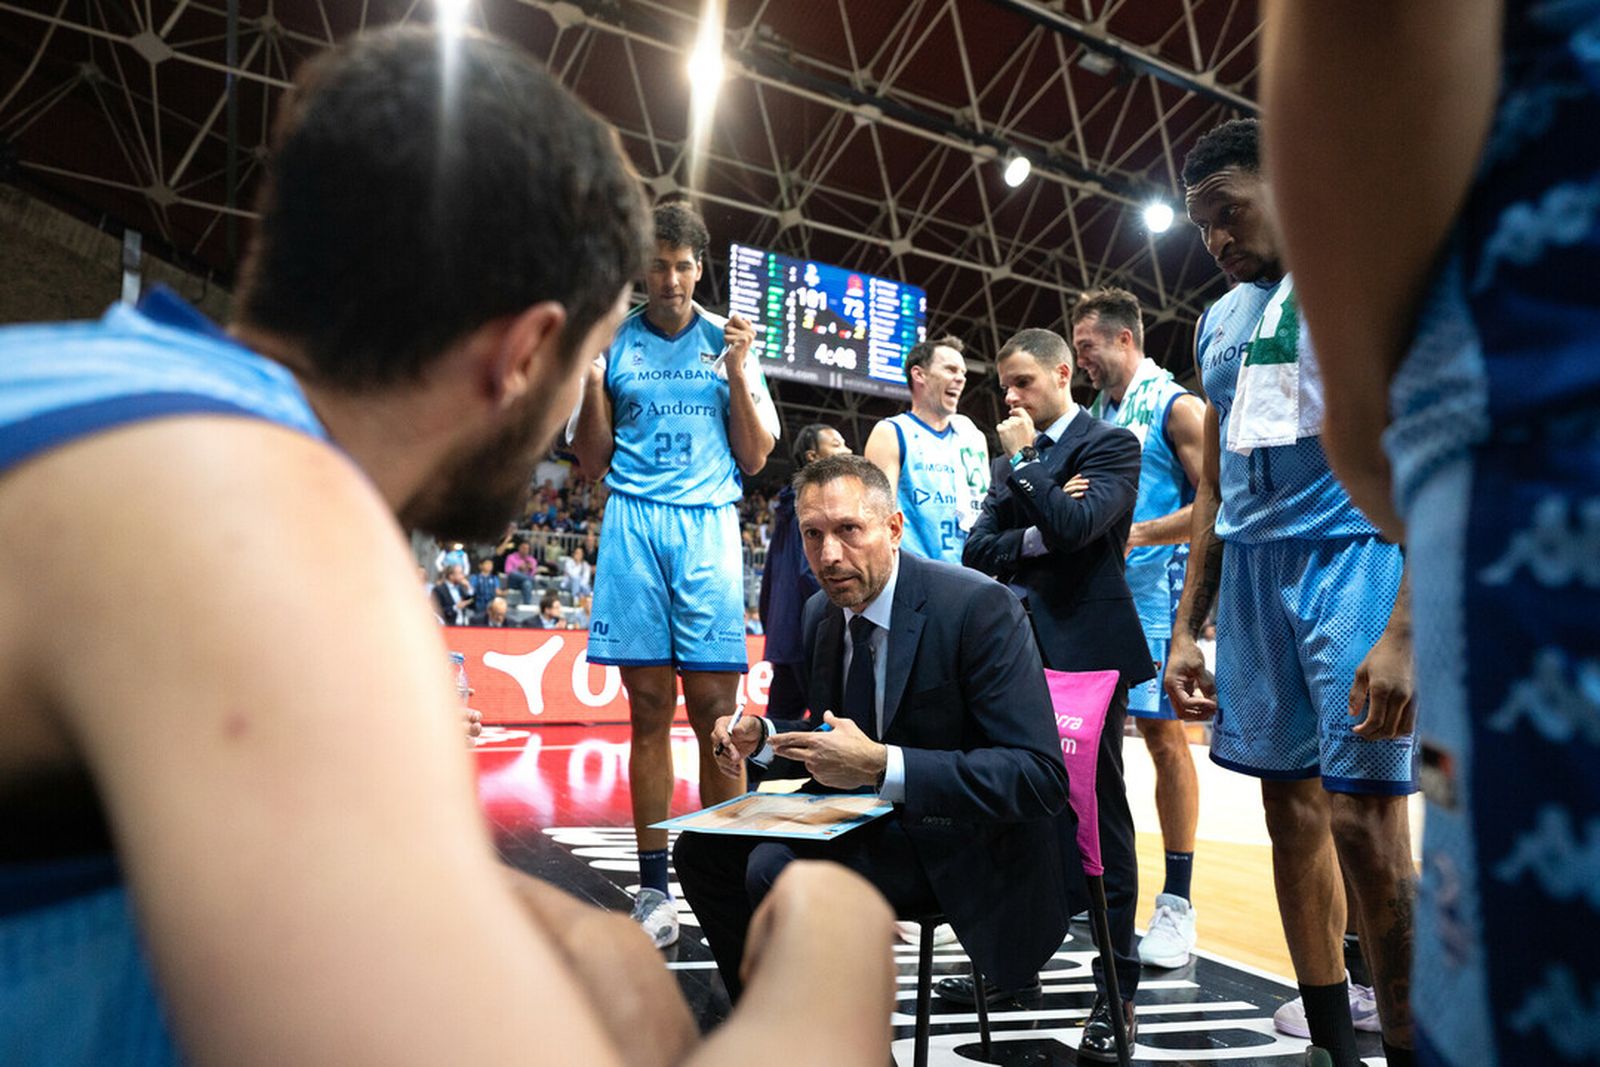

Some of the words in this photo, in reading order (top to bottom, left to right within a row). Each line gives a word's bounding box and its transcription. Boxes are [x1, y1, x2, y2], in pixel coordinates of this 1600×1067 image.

[797, 287, 828, 311] 101
[843, 296, 865, 319] 72
[646, 401, 717, 418] Andorra
[654, 432, 692, 466] 23
[1055, 712, 1083, 730] rra
